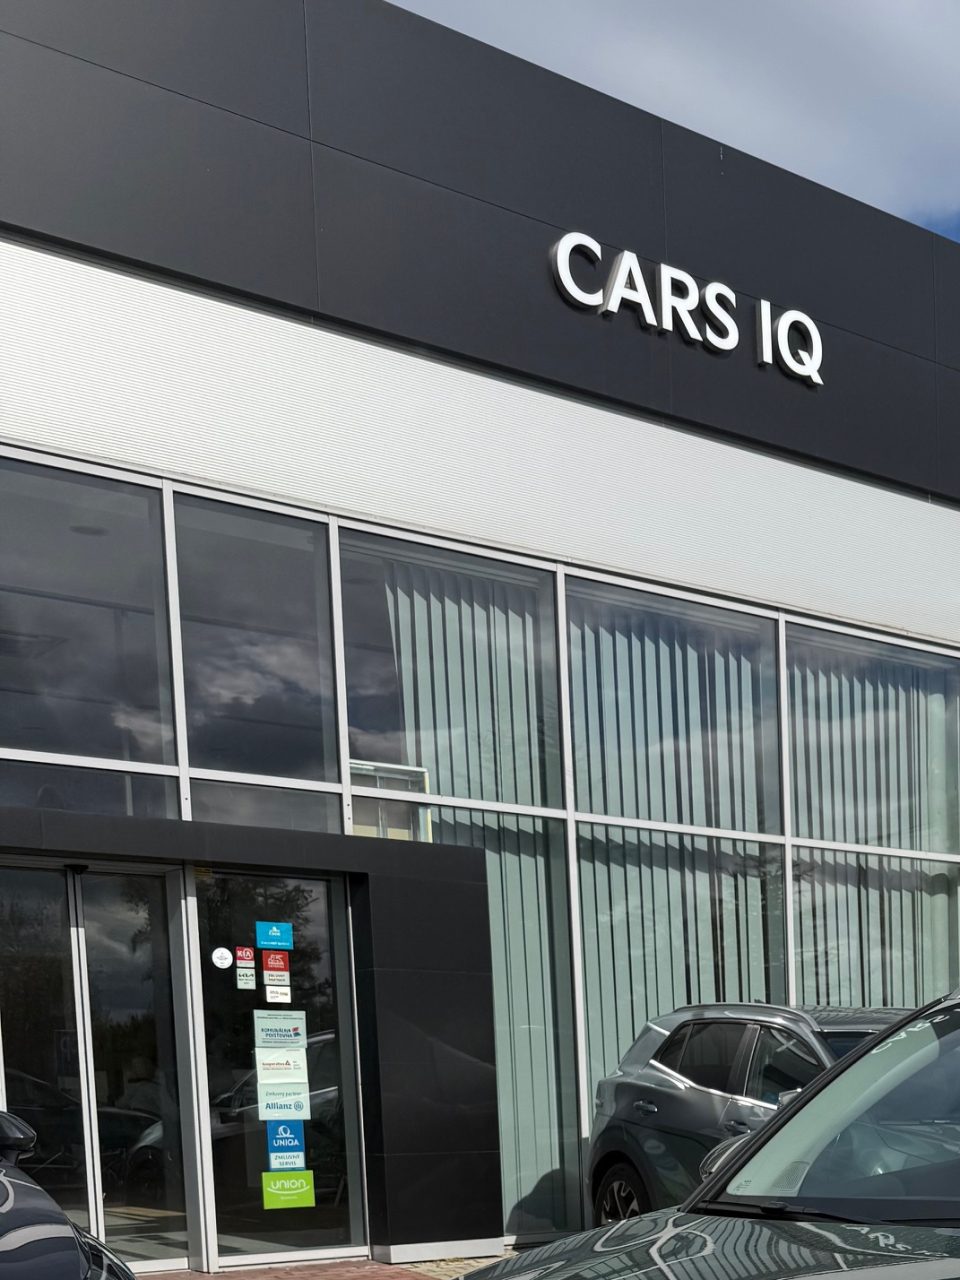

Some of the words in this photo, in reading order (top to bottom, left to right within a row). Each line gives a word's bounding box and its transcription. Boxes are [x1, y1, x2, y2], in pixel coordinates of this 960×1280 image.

[553, 231, 740, 351] CARS
[757, 299, 824, 386] IQ
[265, 1101, 293, 1110] Allianz
[273, 1138, 300, 1147] UNIQA
